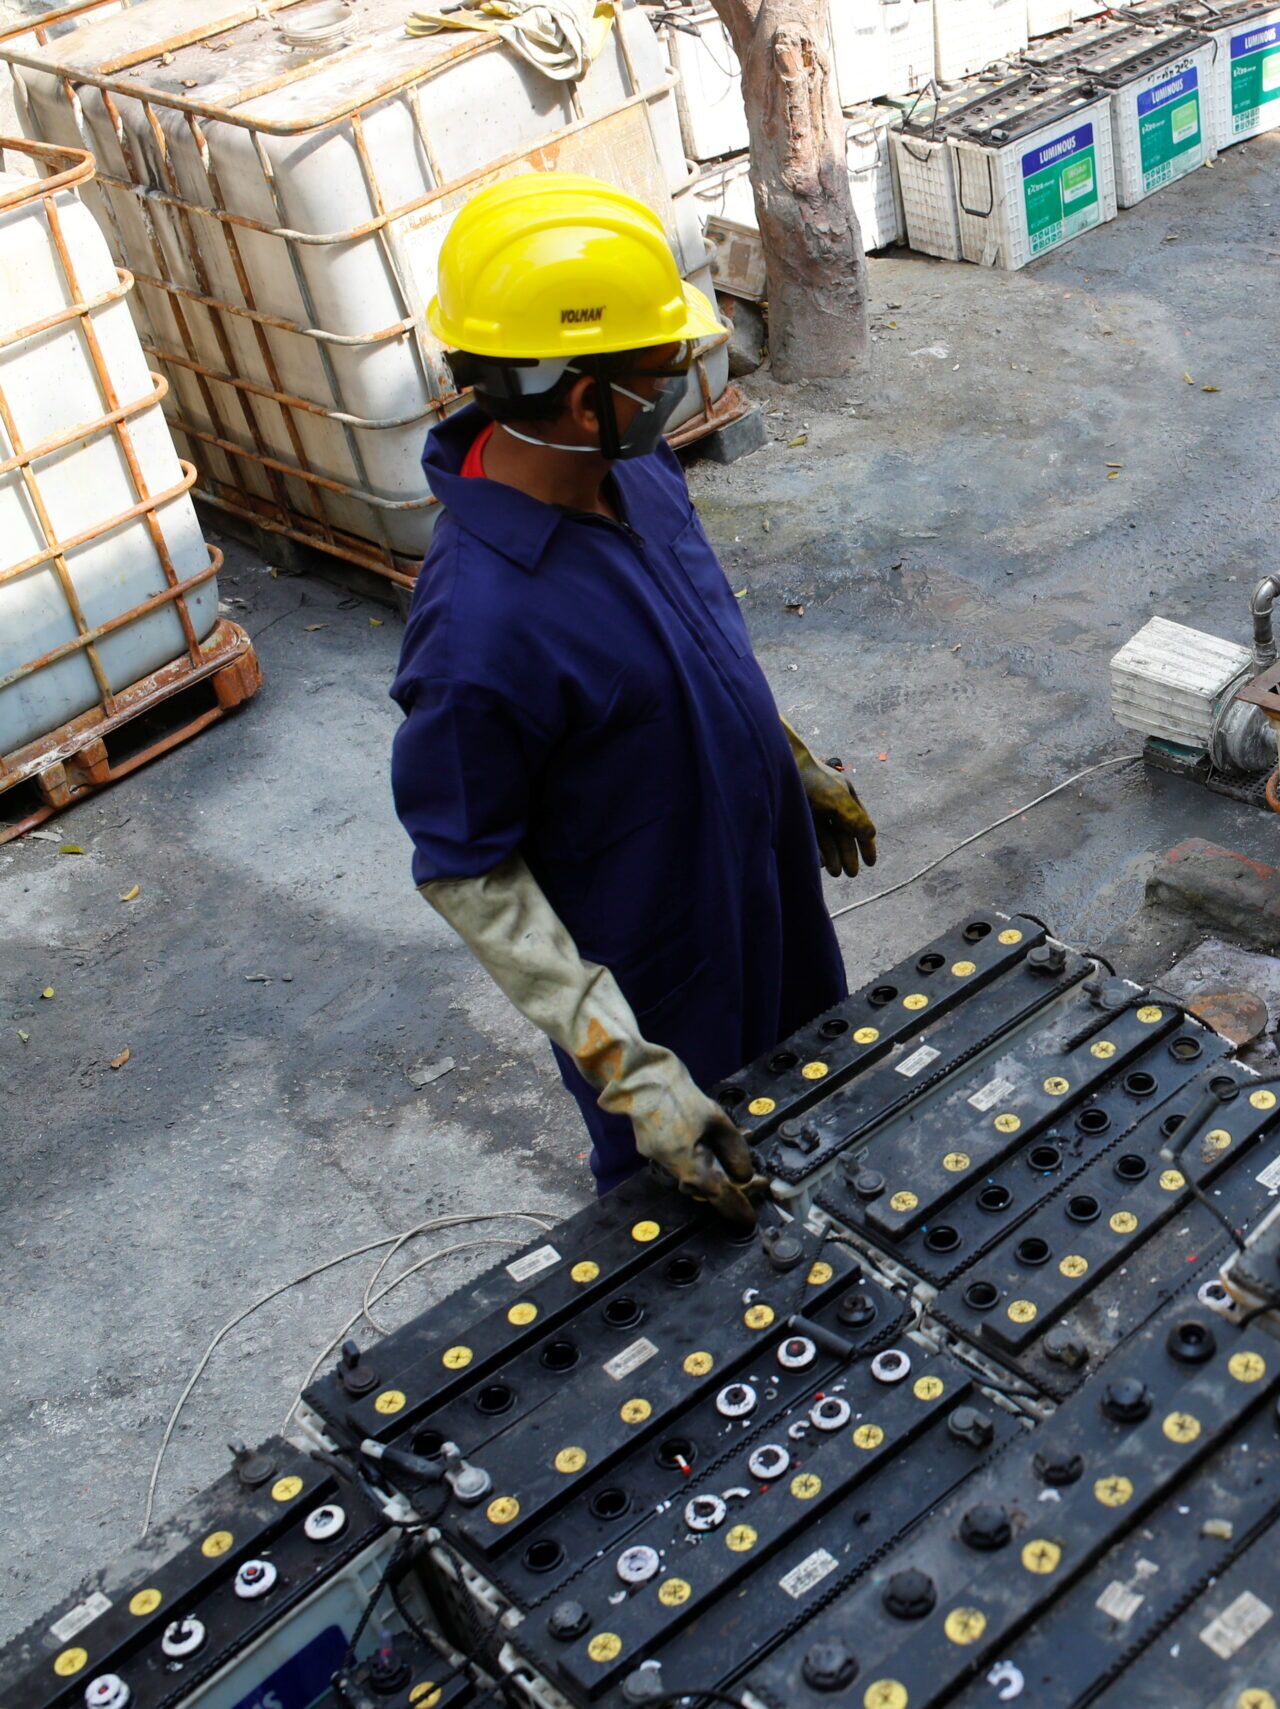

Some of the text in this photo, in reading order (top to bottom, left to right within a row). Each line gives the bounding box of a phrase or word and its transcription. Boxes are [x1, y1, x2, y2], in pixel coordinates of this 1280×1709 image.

[1151, 78, 1184, 104] LUMINOUS
[1039, 135, 1076, 163] LUMINOUS
[561, 307, 603, 323] VOLMAN
